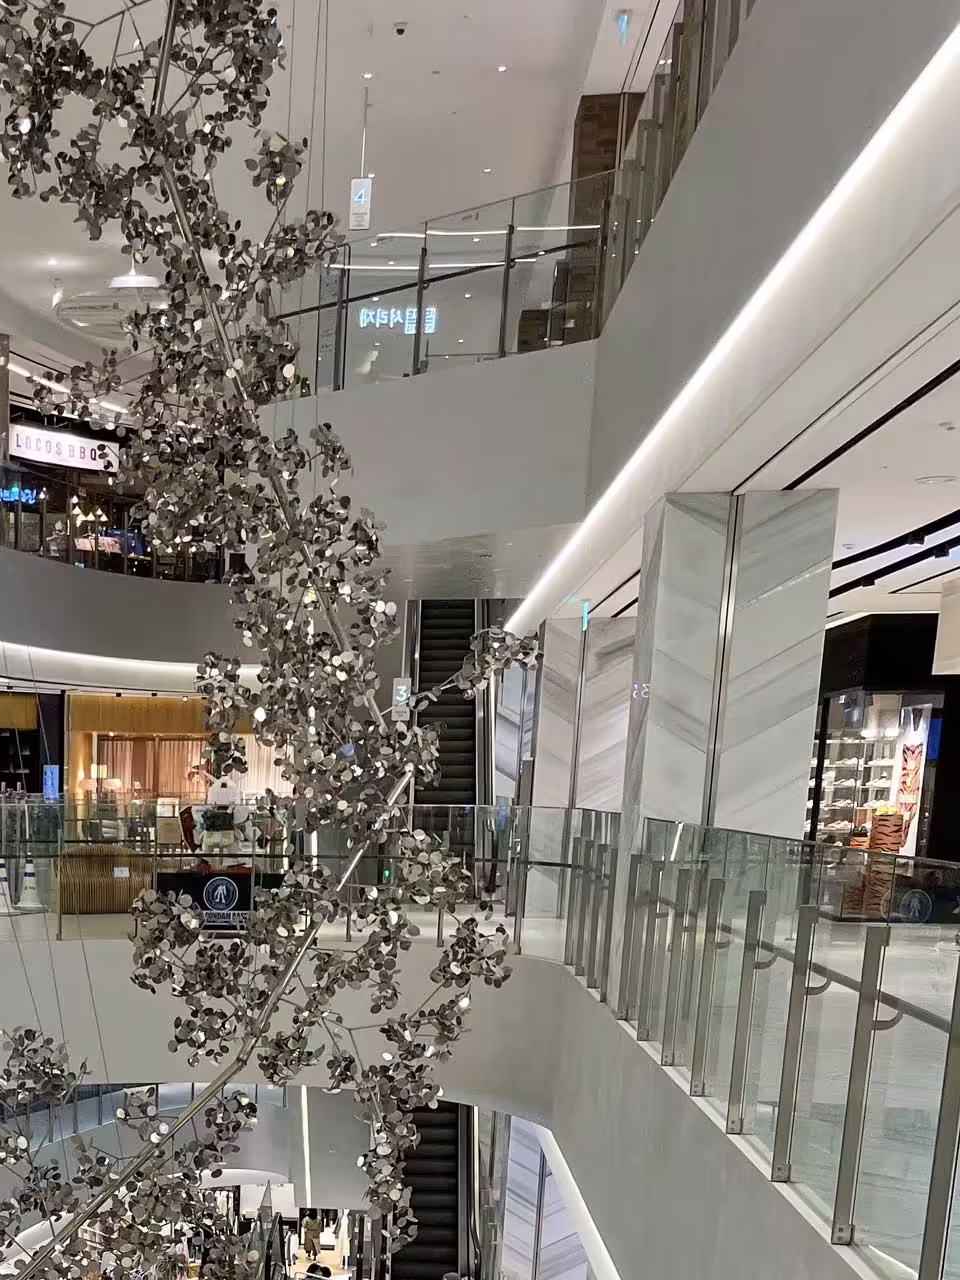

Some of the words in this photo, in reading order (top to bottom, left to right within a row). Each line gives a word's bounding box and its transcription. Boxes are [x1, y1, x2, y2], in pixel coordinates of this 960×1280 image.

[354, 188, 367, 205] 4
[16, 433, 62, 456] LOCOS
[68, 444, 97, 461] BBQ
[396, 684, 407, 701] 3
